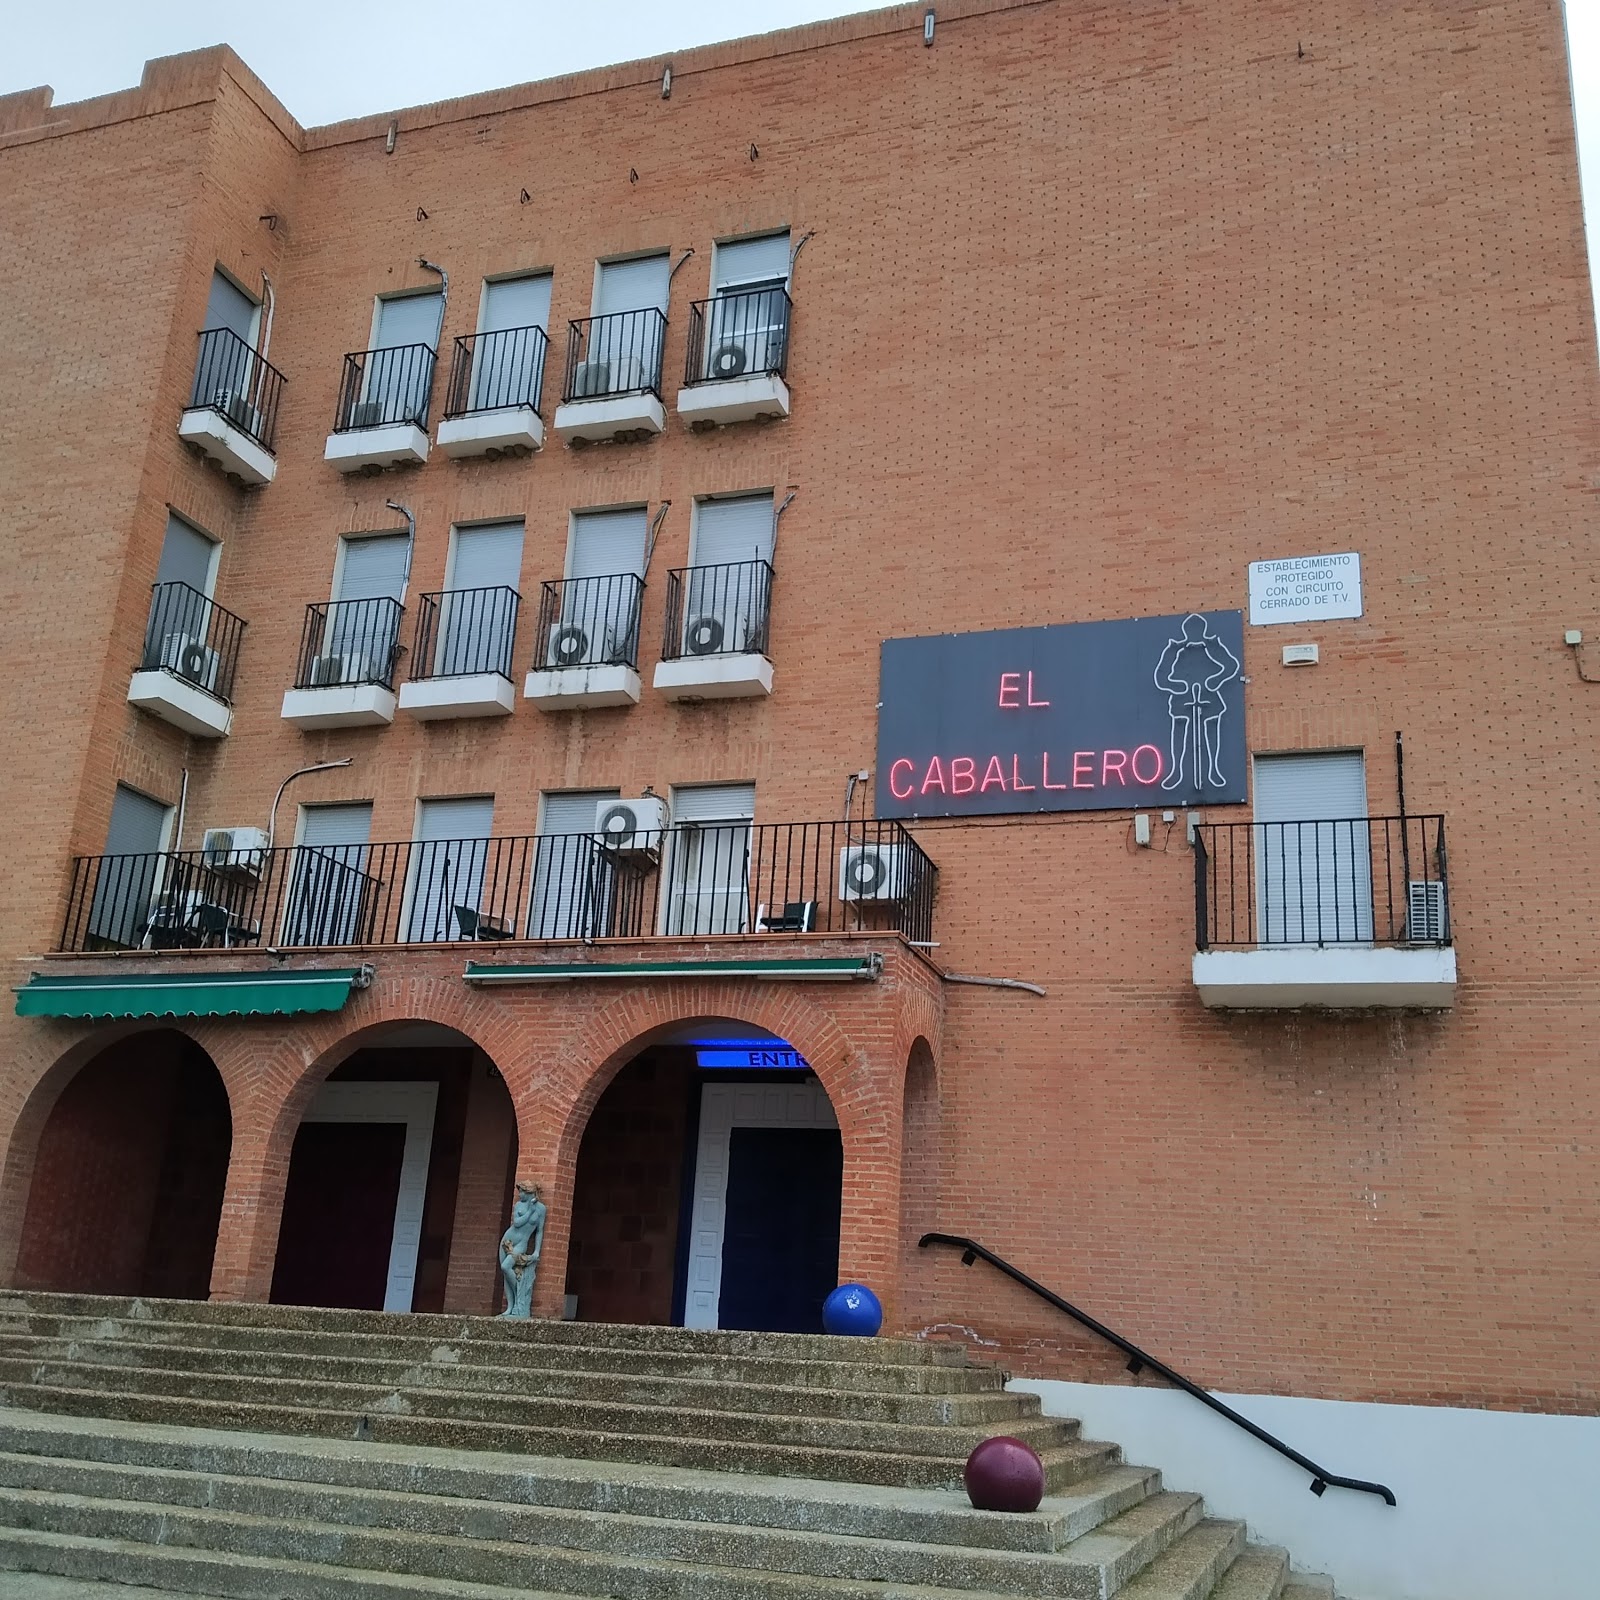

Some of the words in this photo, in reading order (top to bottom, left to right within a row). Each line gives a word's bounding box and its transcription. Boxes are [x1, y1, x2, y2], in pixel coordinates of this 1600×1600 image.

[1257, 556, 1350, 573] ESTABLECIMIENTO
[1275, 570, 1333, 583] PROTEGIDO
[1266, 586, 1289, 597] CON
[1295, 581, 1344, 594] CIRCUITO
[1260, 596, 1310, 609] CERRADO
[1314, 595, 1329, 604] DE
[999, 670, 1050, 707] EL
[890, 744, 1163, 798] CABALLERO
